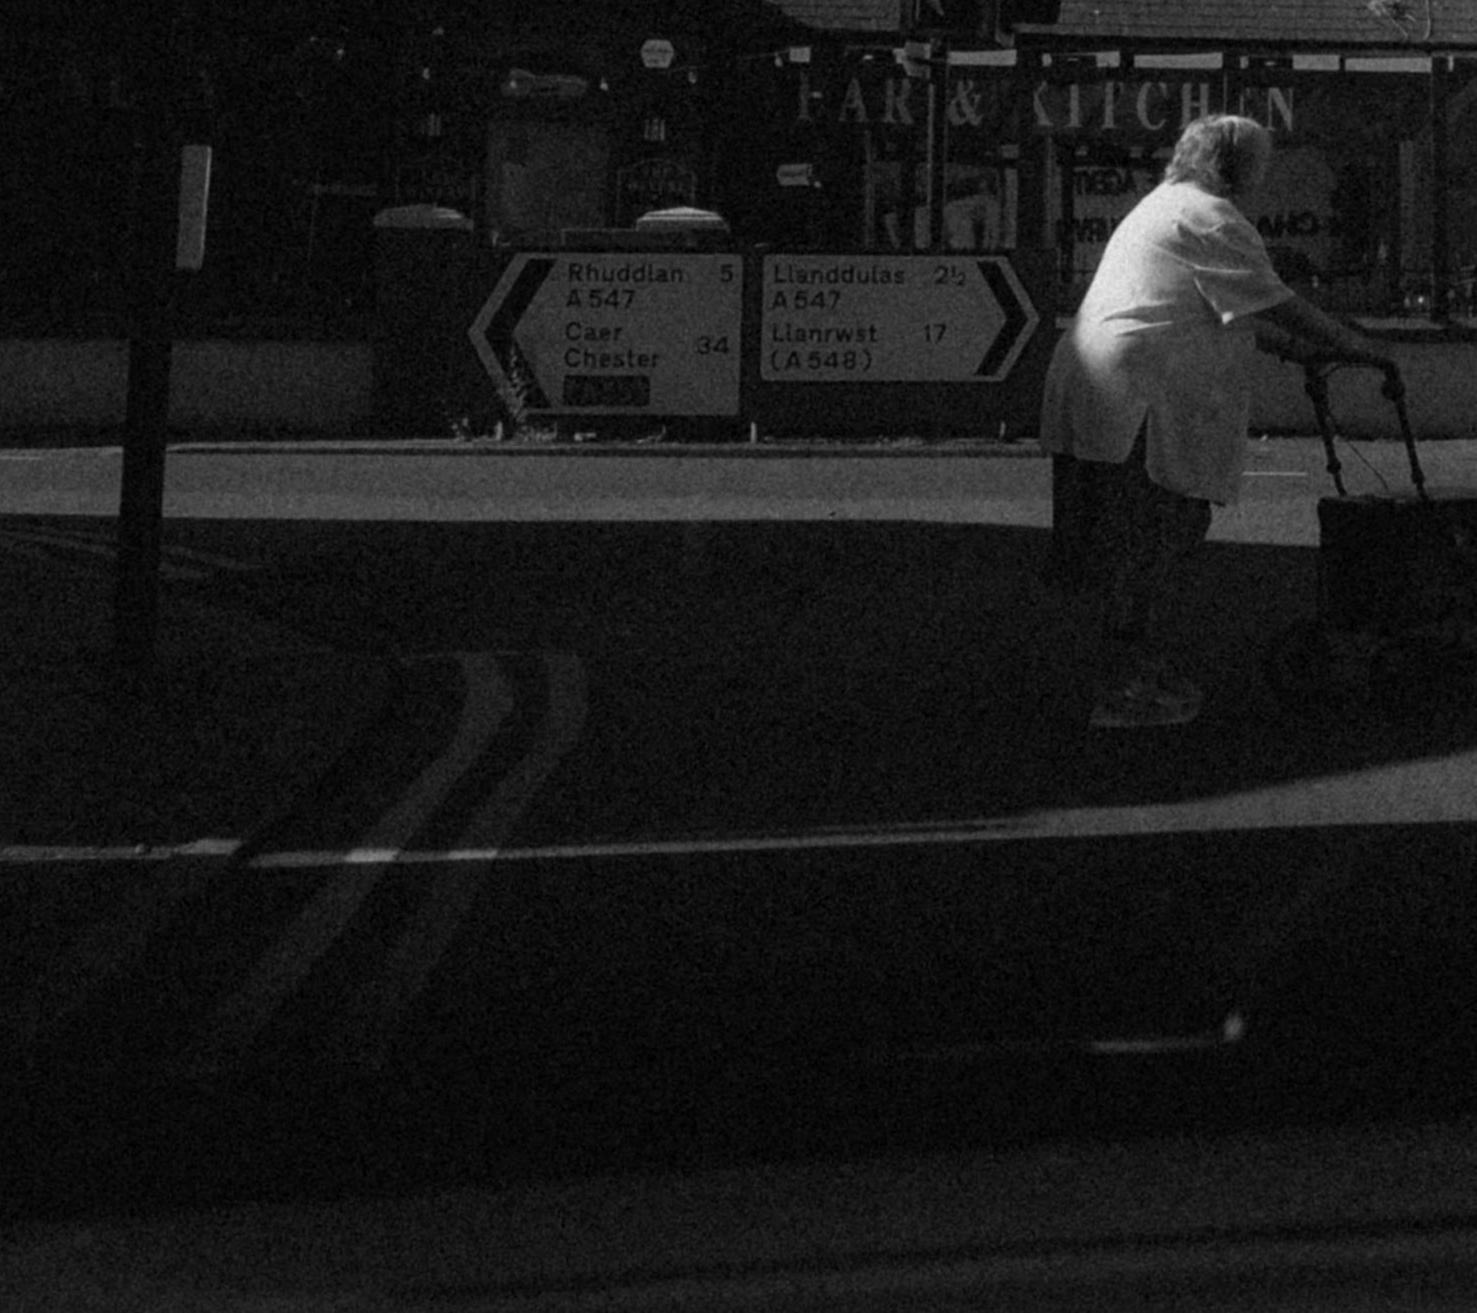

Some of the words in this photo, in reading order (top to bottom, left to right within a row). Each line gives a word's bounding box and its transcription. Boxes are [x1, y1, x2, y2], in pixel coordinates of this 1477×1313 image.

[945, 78, 984, 127] &
[567, 262, 684, 284] Rhuddlan
[719, 263, 735, 284] 5
[773, 264, 906, 285] Llanddulas
[564, 321, 623, 342] Caer
[695, 335, 731, 355] 34
[772, 323, 879, 343] Llanrwst
[923, 323, 948, 342] 17
[563, 347, 660, 369] Chester
